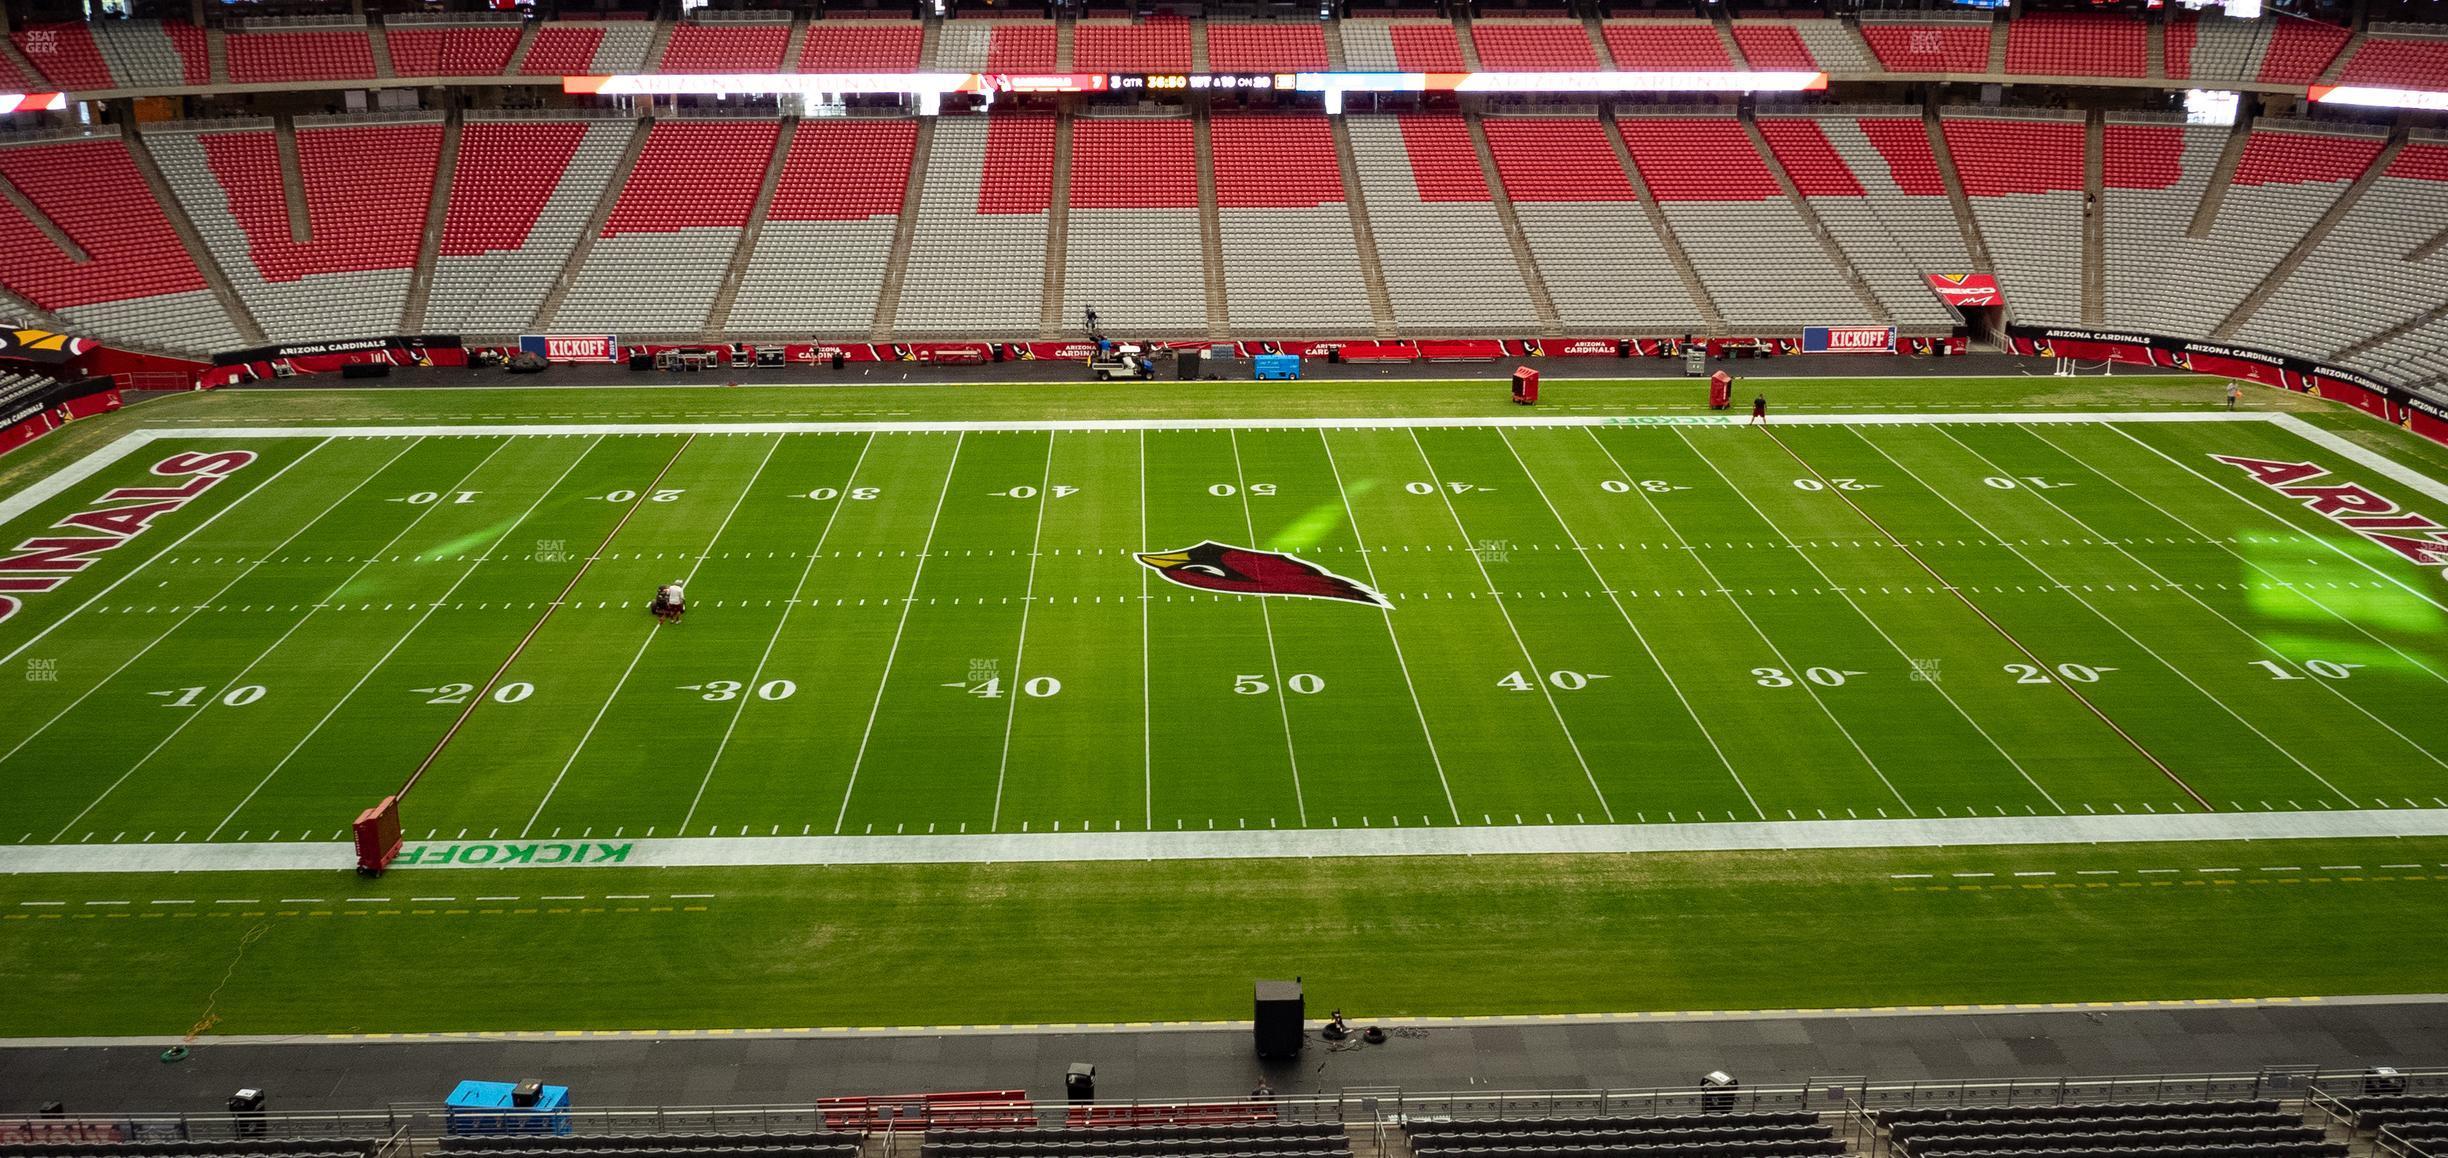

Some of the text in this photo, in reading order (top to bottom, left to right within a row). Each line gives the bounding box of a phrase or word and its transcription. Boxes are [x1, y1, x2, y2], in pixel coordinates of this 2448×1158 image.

[1122, 78, 1143, 88] QTR
[1237, 77, 1253, 88] ON
[279, 338, 387, 356] ARIZONA CARDINALS
[547, 339, 606, 357] KICKOFF
[1829, 330, 1886, 348] KICKOFF
[2045, 329, 2151, 345] ARIZONA CARDINALS
[1564, 346, 1616, 354] CARDINALS
[2184, 342, 2285, 366] ARIZONA CARDINALS
[2313, 365, 2389, 396] ARIZONA CARDINALS
[11, 402, 45, 422] CARDINALS
[2408, 398, 2438, 416] ARIZONA
[2205, 453, 2448, 583] ARIZ
[0, 450, 259, 624] INALS
[1496, 670, 1588, 691] 40
[1750, 666, 1847, 688] 30
[2003, 662, 2101, 684] 20
[2248, 658, 2351, 681] 10
[426, 681, 536, 704] 20
[701, 679, 797, 701] 30
[967, 676, 1062, 698] 40
[1233, 673, 1325, 695] 50
[160, 684, 268, 707] 10
[390, 843, 634, 866] KICKOFF
